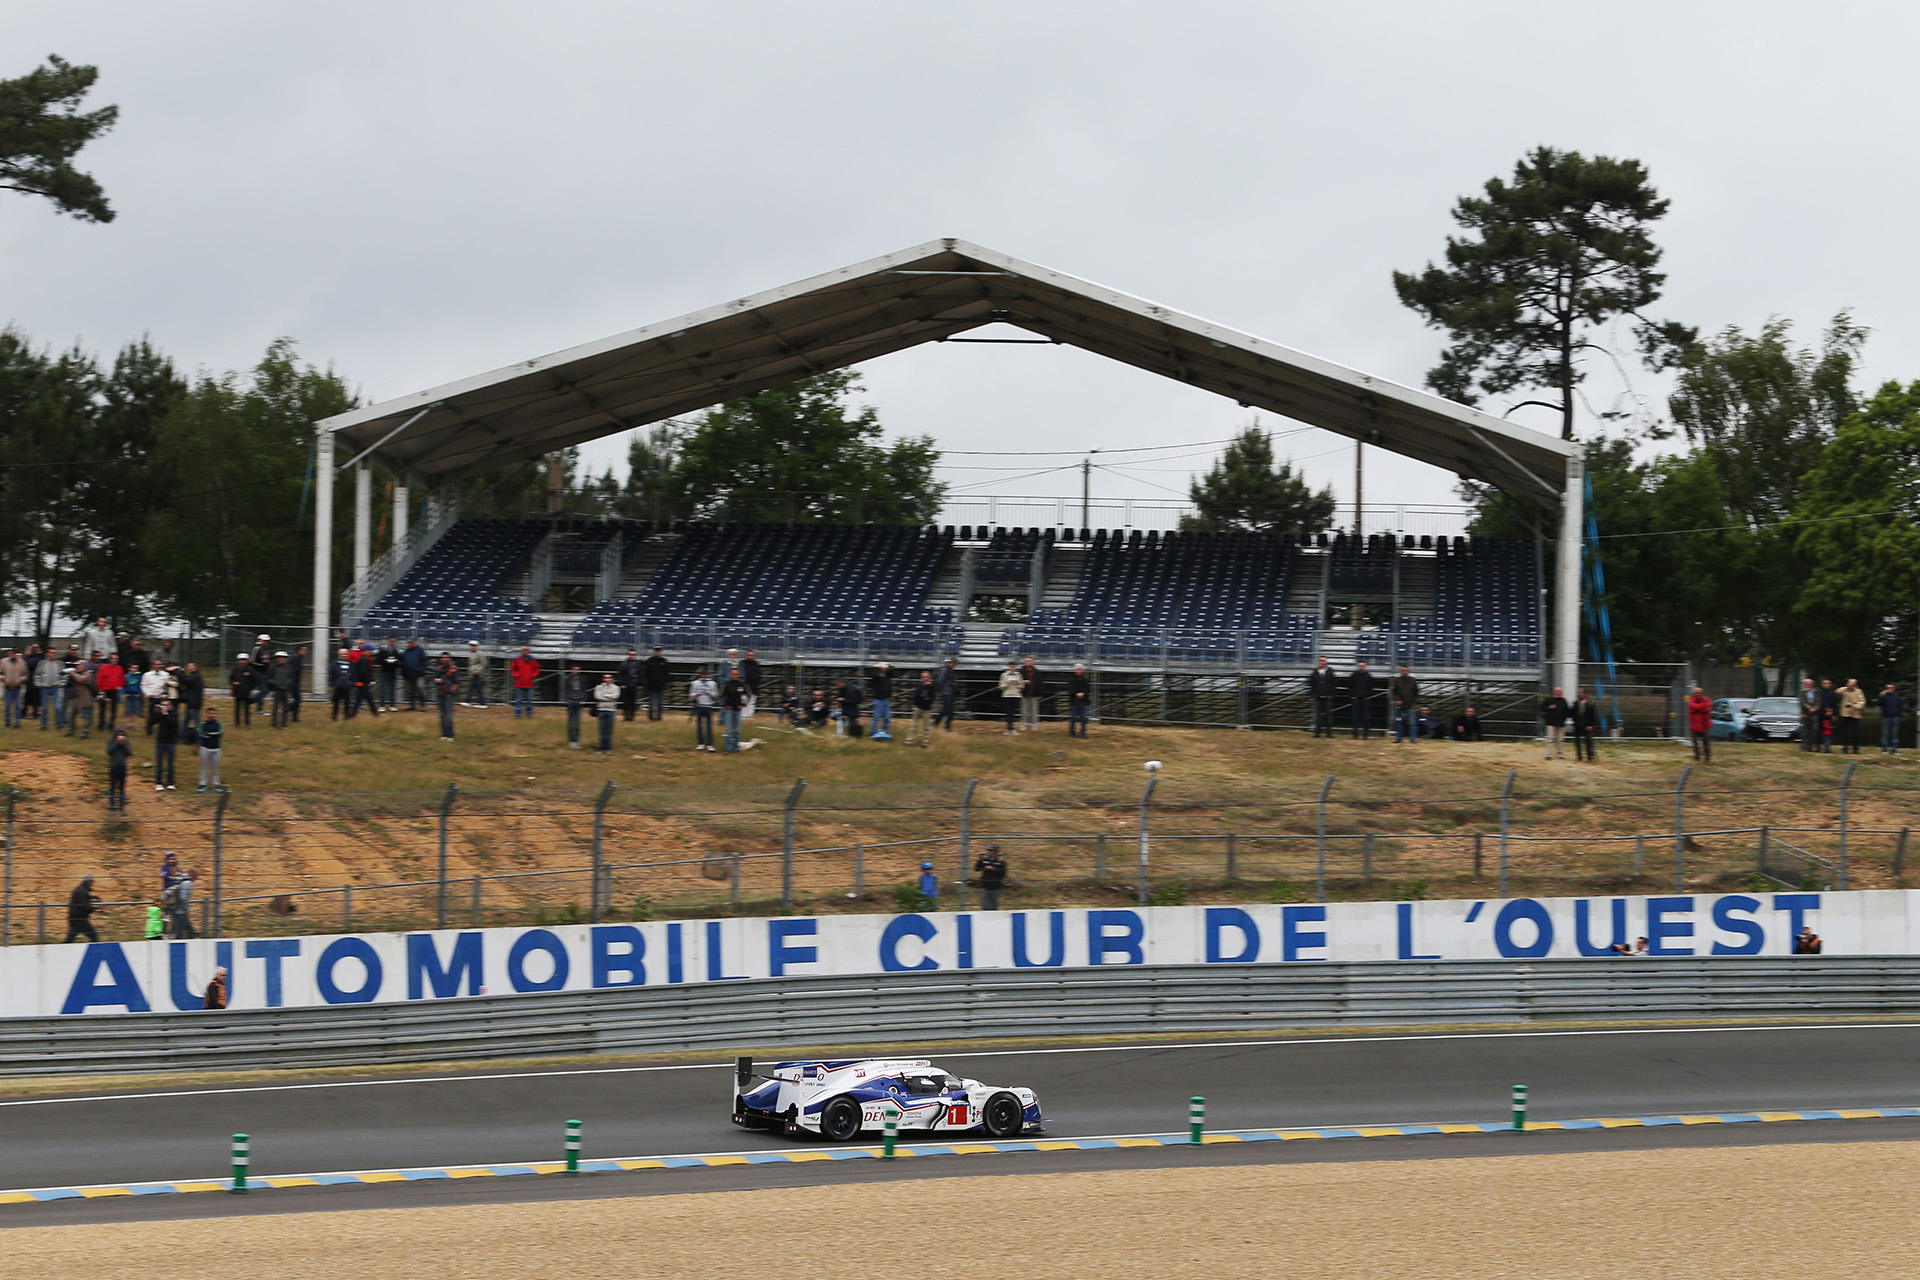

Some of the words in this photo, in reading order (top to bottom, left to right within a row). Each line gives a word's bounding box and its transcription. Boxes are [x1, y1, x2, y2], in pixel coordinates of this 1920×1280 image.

[1206, 906, 1327, 963] DE
[1398, 894, 1821, 960] L'OUEST
[864, 1111, 904, 1122] DENO
[951, 1108, 957, 1124] 1
